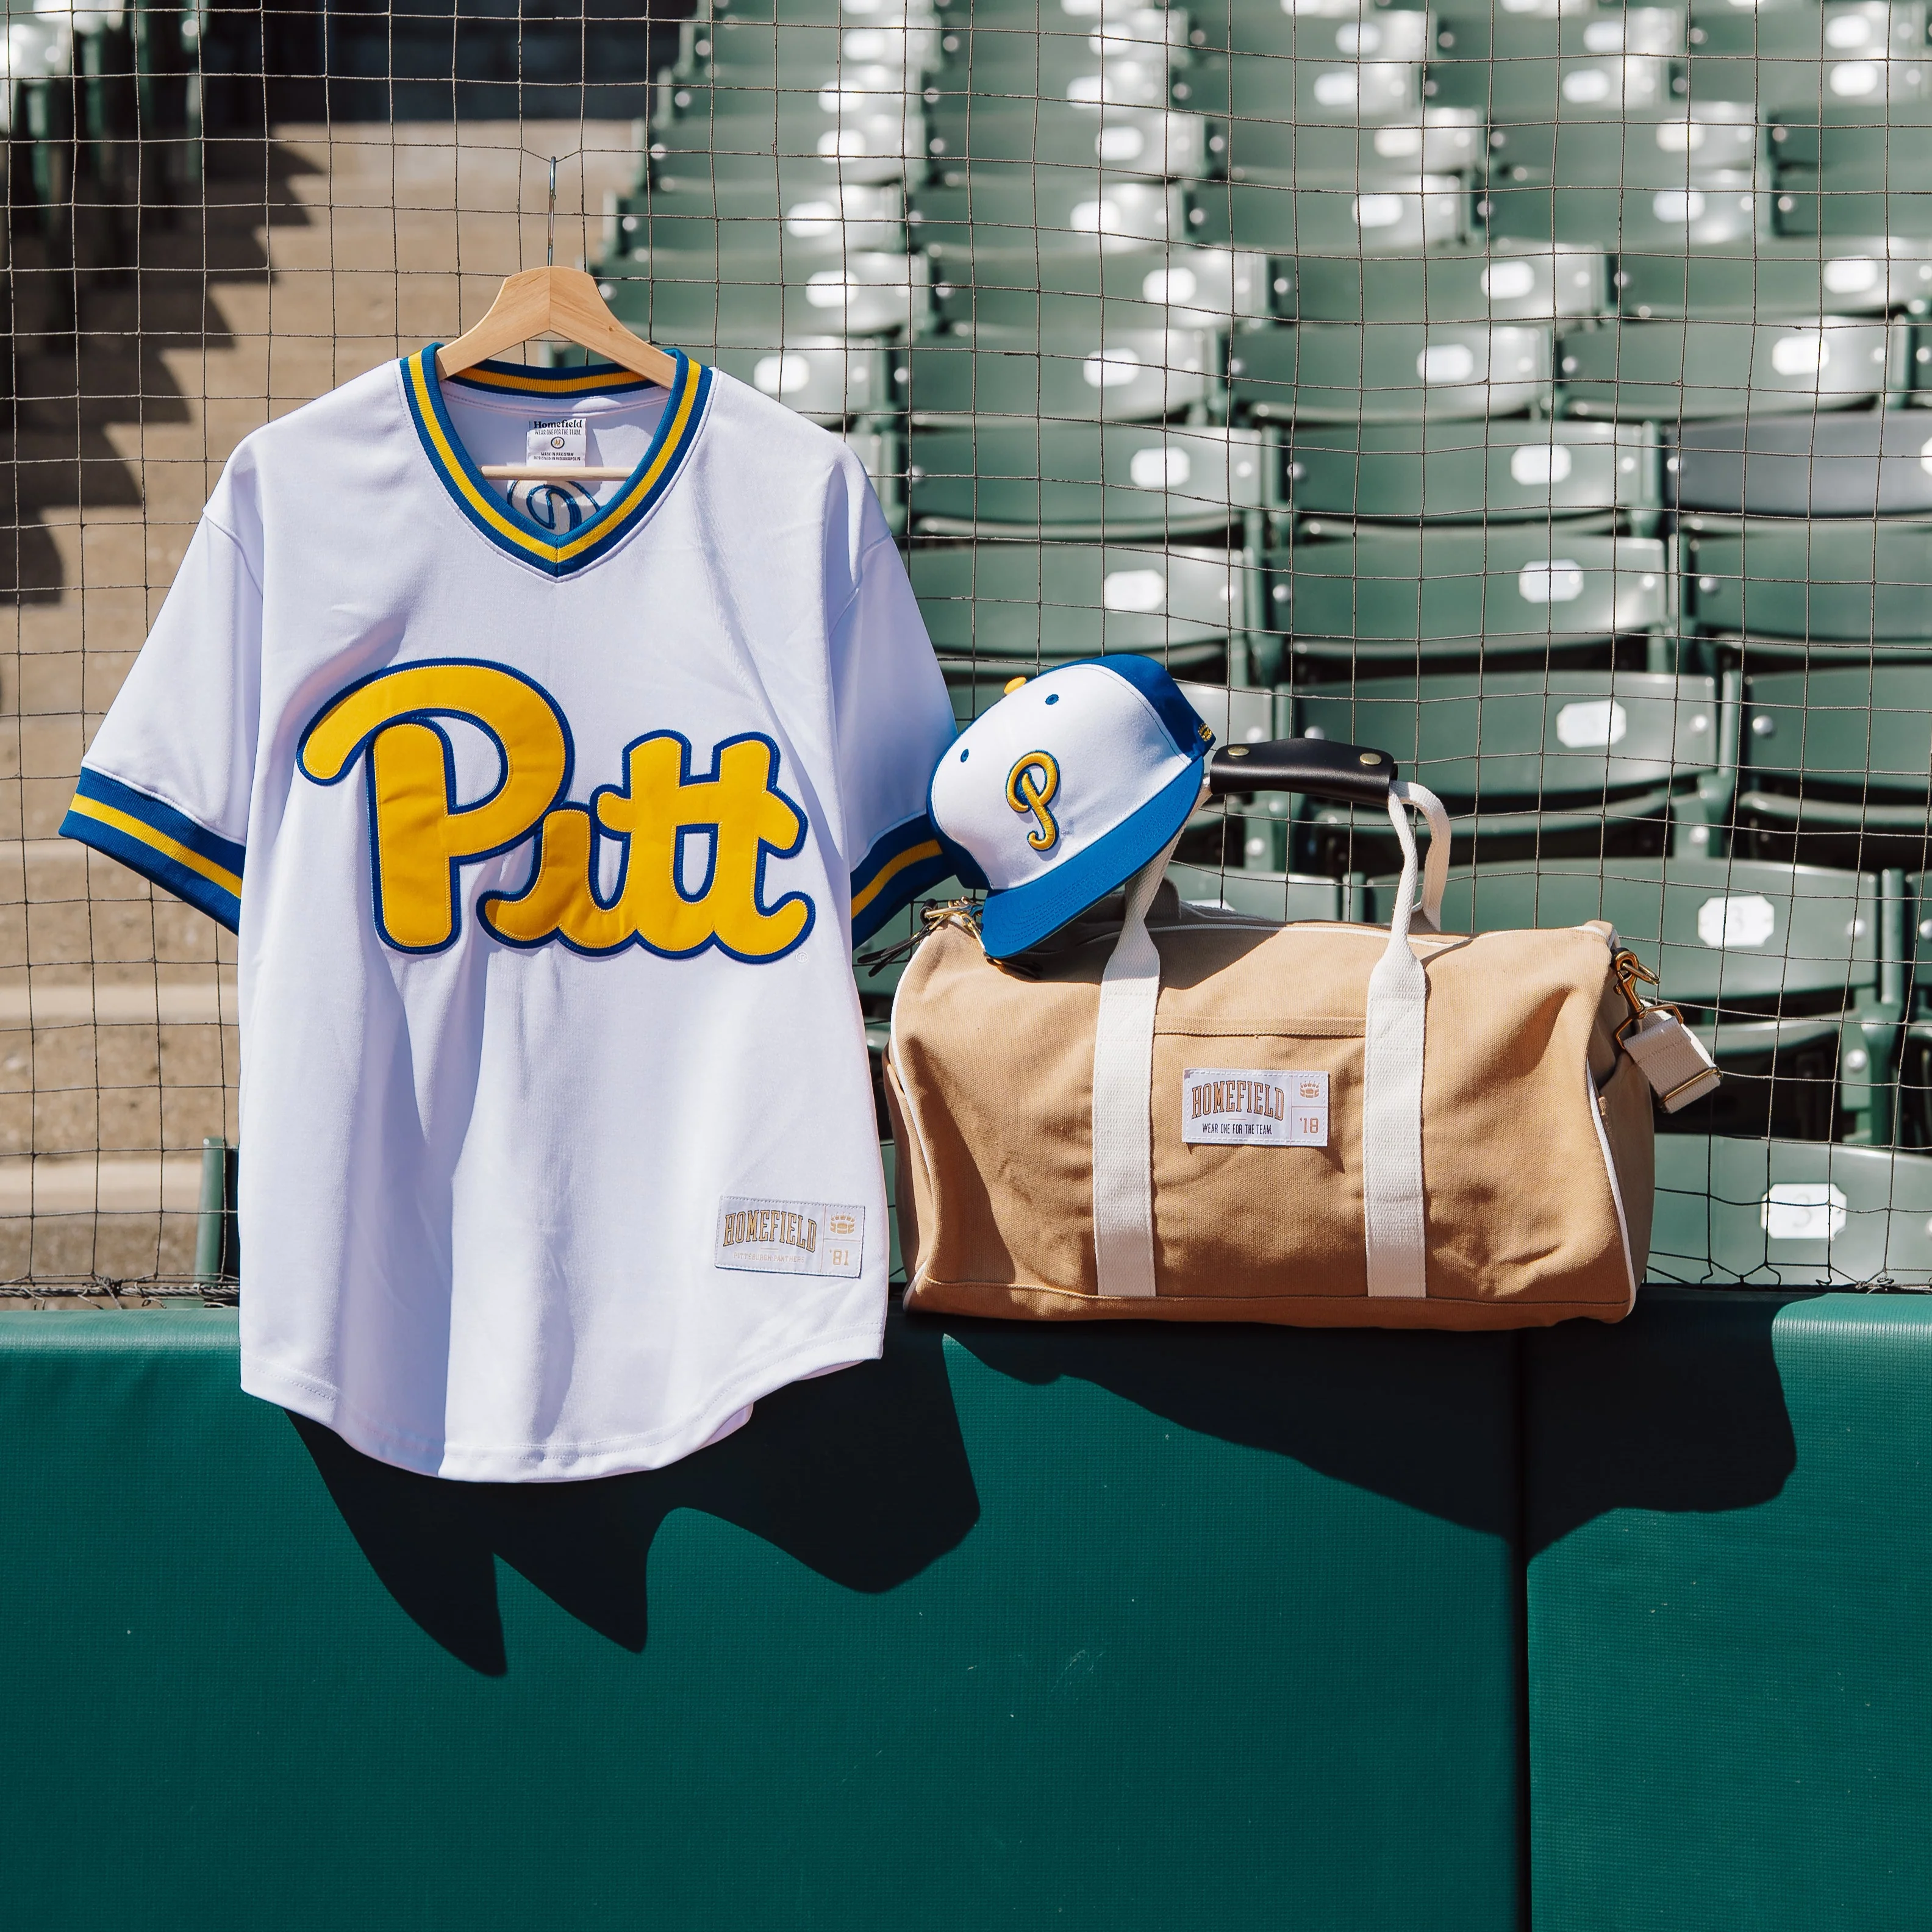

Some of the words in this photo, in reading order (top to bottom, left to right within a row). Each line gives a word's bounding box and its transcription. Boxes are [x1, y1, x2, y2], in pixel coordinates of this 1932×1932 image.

[534, 419, 582, 429] Homefield
[296, 657, 816, 965] Pitt
[1006, 750, 1060, 851] P
[1191, 1080, 1284, 1121] HOMEFIELD
[1203, 1123, 1218, 1134] WEAR
[1220, 1123, 1231, 1134] ONE
[1233, 1124, 1243, 1134] FOR
[1245, 1124, 1254, 1135] THE
[1256, 1124, 1273, 1135] TEAM.
[1792, 1192, 1814, 1228] 3
[723, 1209, 817, 1253] HOMEFIELD
